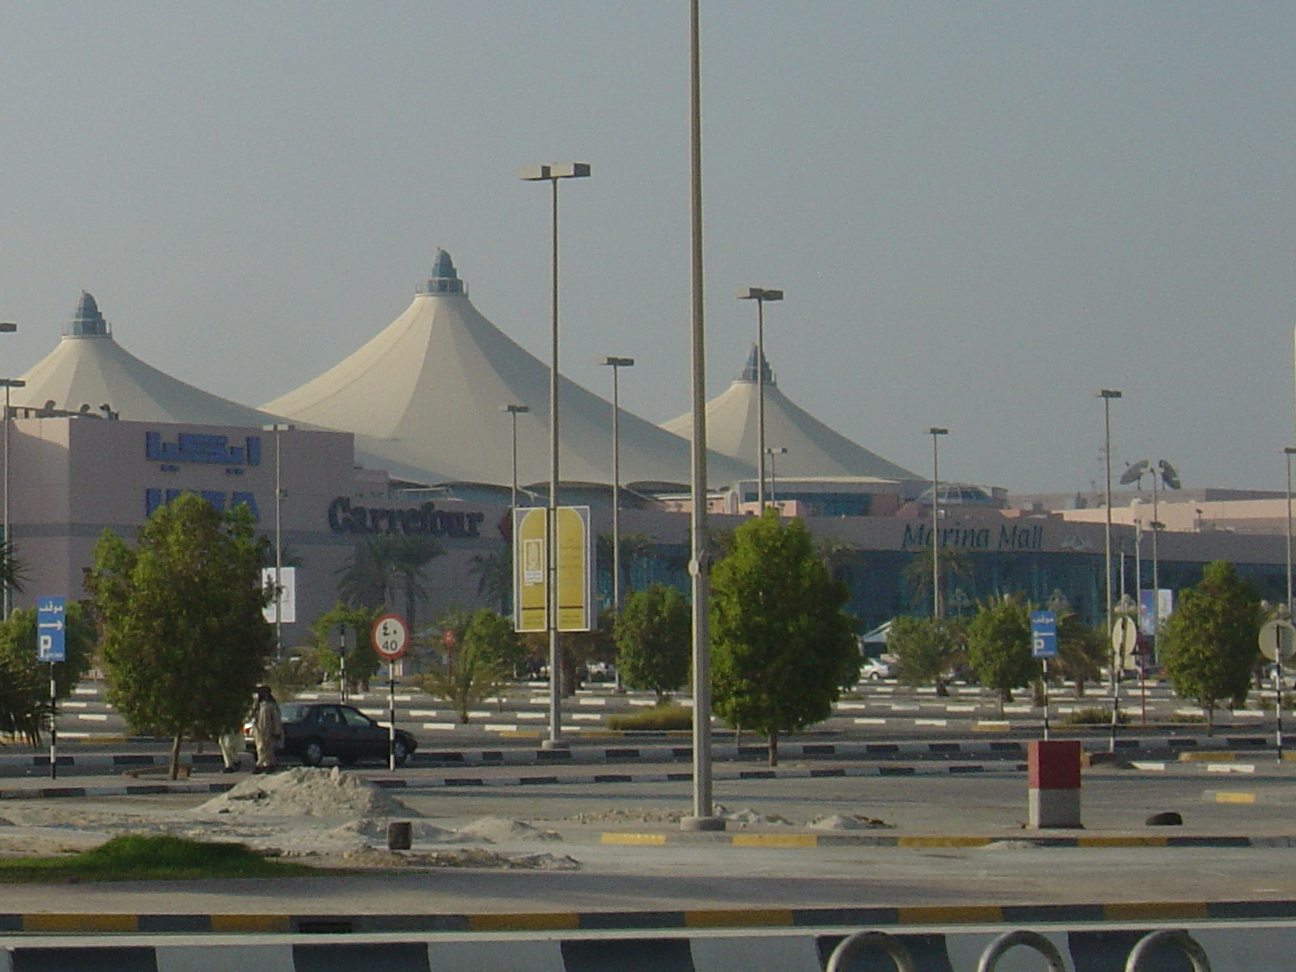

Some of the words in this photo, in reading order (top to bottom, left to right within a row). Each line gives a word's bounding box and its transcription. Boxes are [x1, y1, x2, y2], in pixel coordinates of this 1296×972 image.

[328, 496, 484, 538] Carrefour
[902, 522, 990, 549] Marina
[998, 524, 1043, 549] Mall
[382, 640, 398, 651] 40
